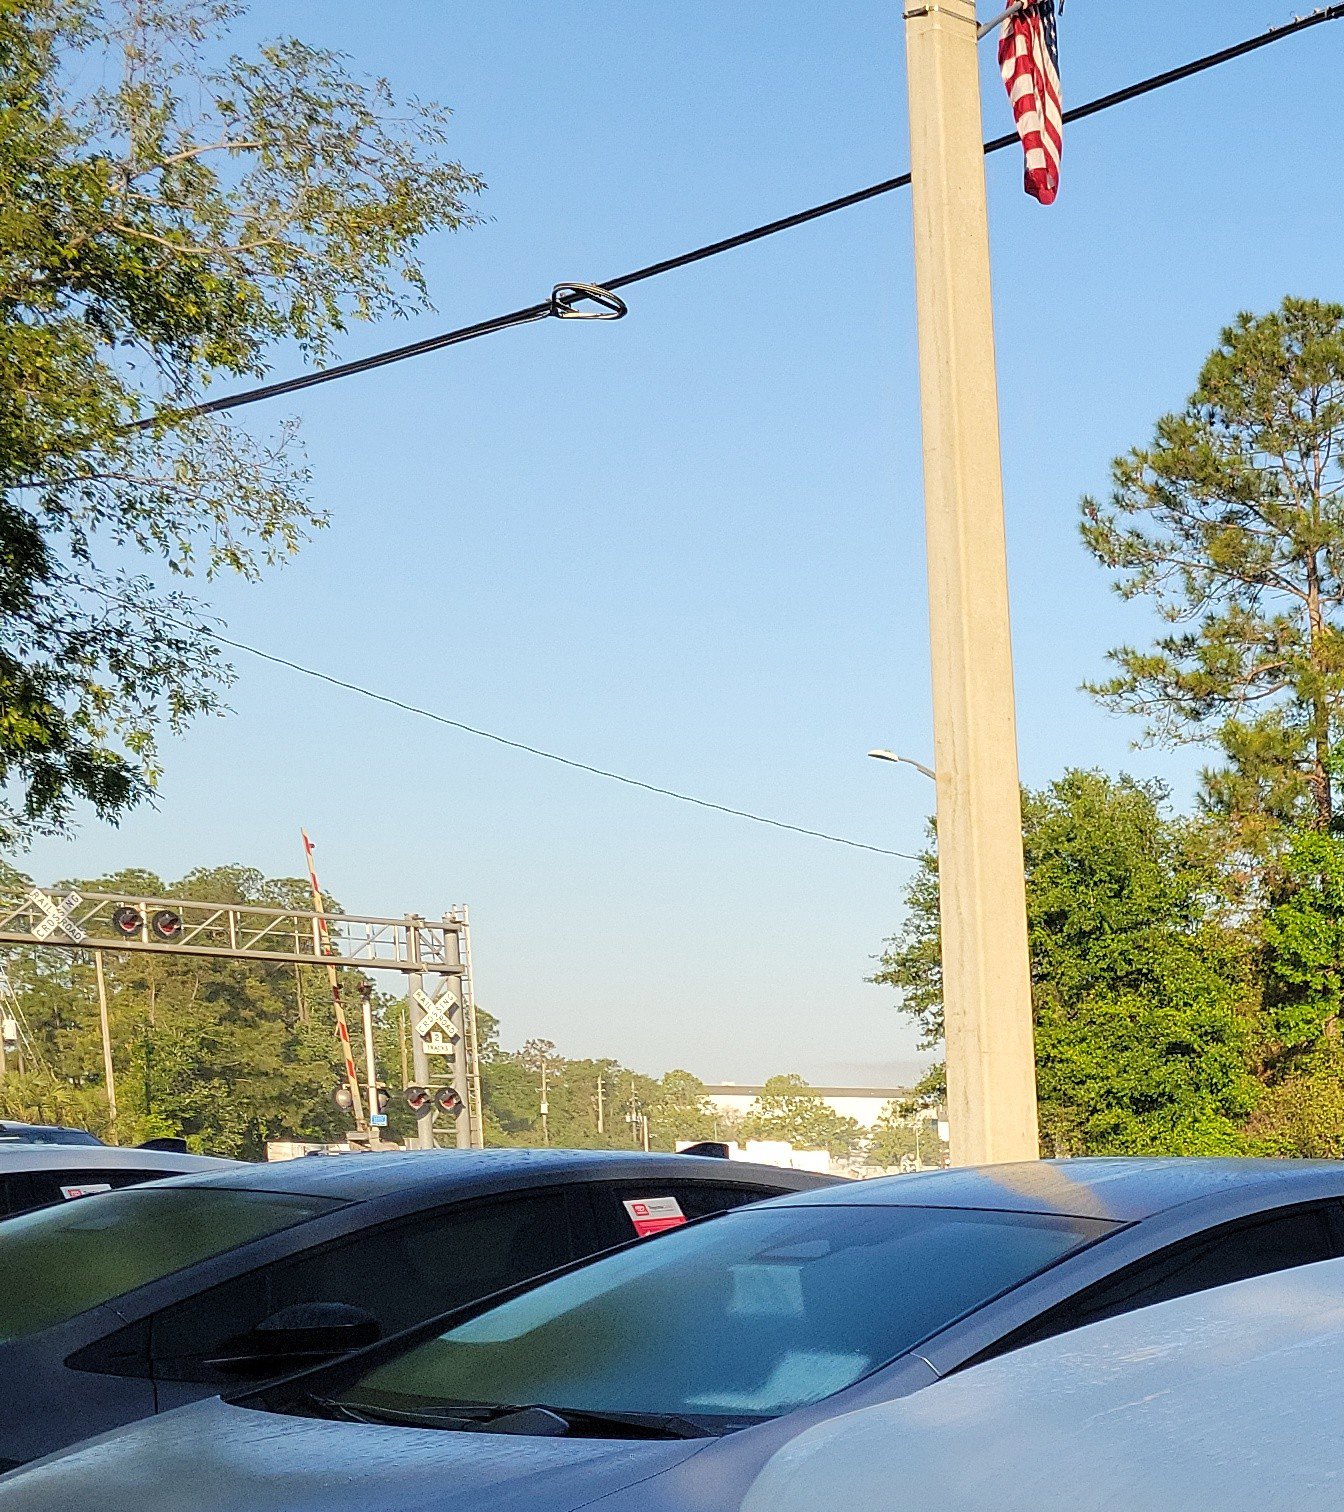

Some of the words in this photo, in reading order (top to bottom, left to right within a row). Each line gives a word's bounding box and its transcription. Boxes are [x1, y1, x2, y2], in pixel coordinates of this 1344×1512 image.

[36, 894, 79, 938] CROSSING
[418, 993, 454, 1034] CROSSING
[427, 1044, 449, 1052] TRACKS
